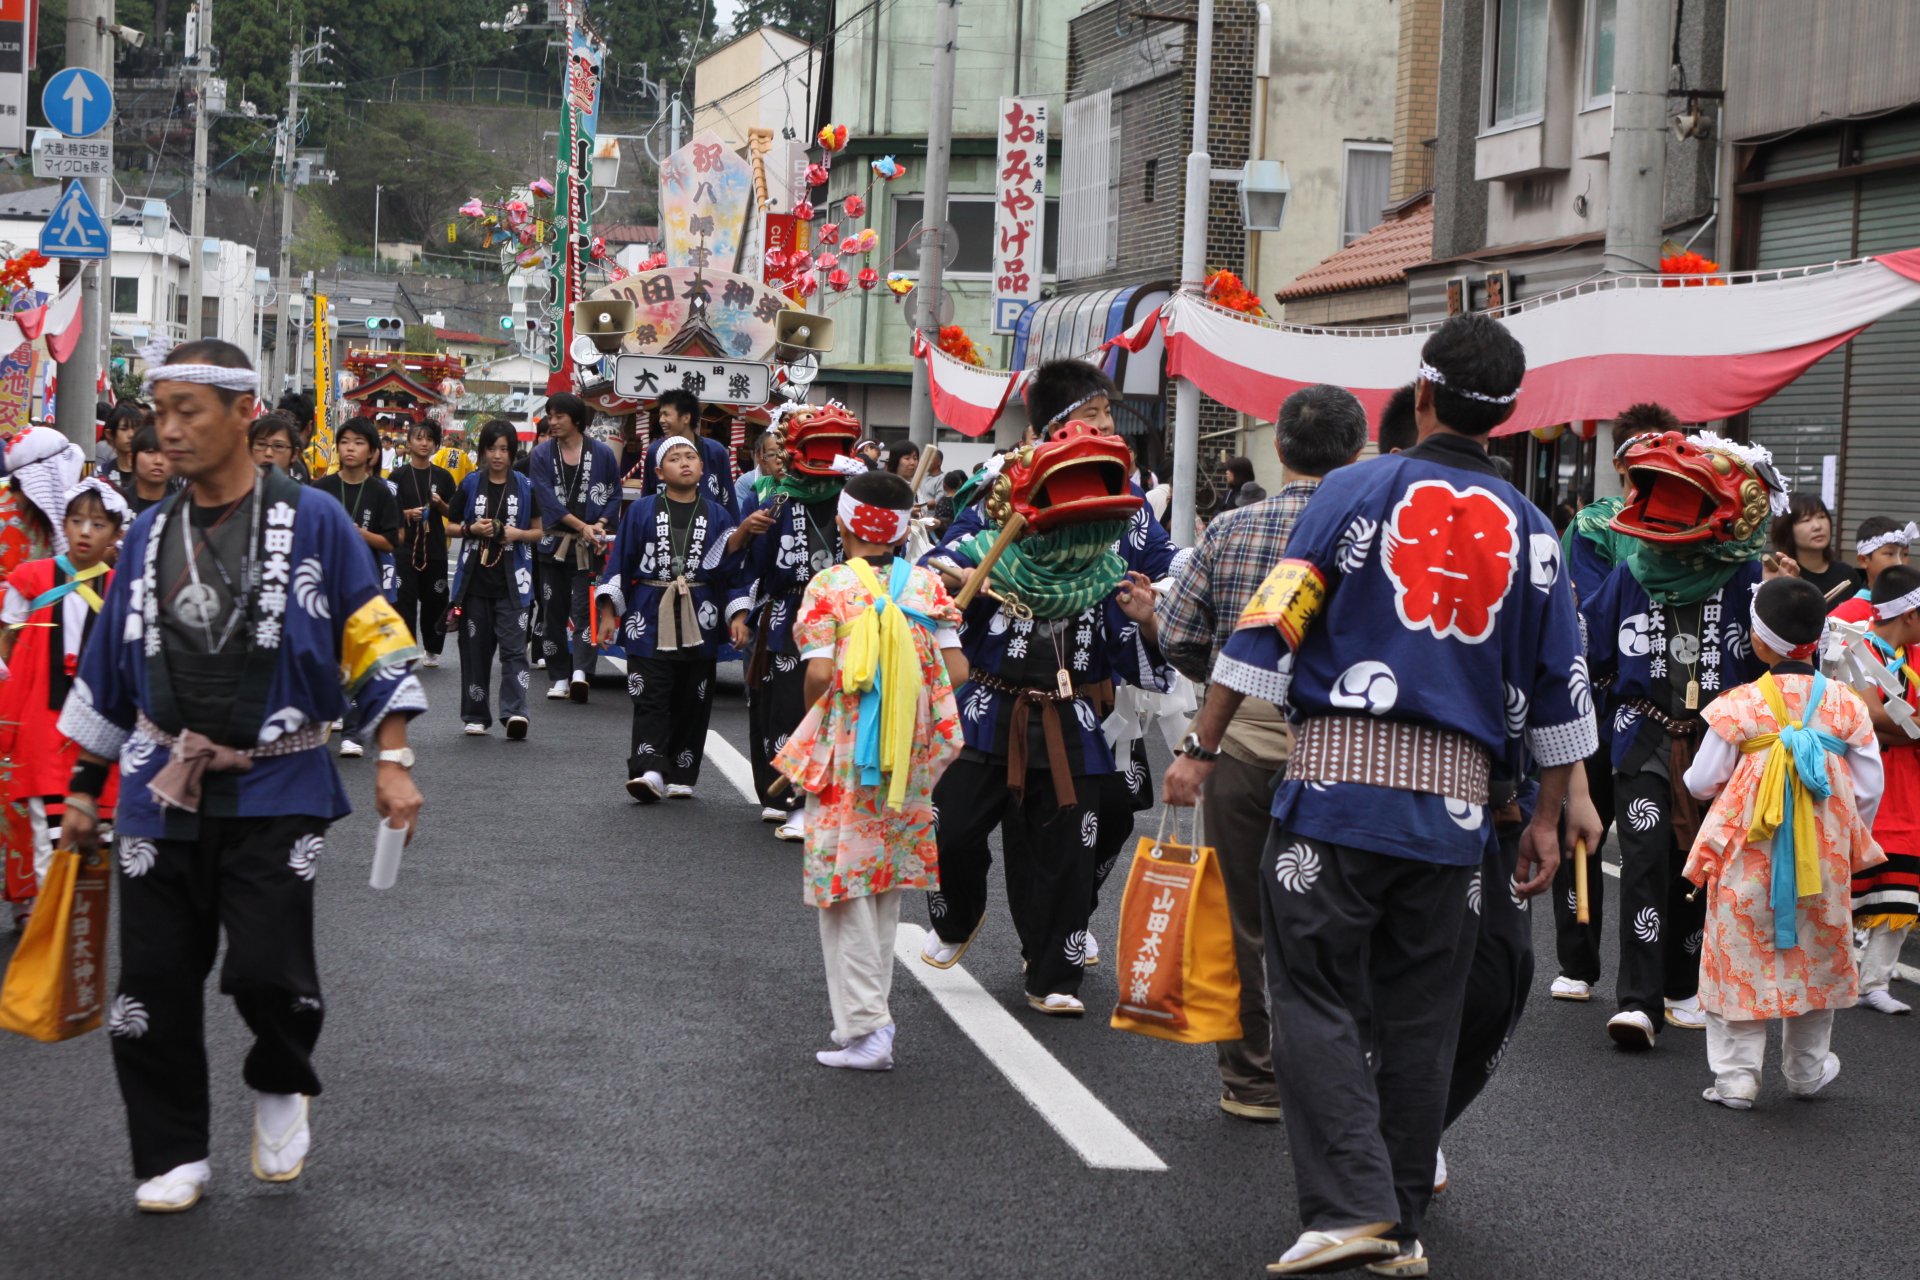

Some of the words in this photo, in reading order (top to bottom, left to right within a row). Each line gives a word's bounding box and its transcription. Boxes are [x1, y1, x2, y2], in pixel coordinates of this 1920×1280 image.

[44, 158, 108, 174] マイクロを除く
[1031, 106, 1046, 195] 三陸名産
[997, 102, 1035, 294] おみやげ品
[1001, 302, 1022, 328] P
[1, 342, 32, 438] 電池交
[664, 362, 725, 377] 山田
[254, 501, 296, 649] 山田大神楽
[656, 511, 672, 581] 山田大神楽
[685, 515, 707, 583] 山田大神楽
[792, 502, 809, 582] 山田大神楽
